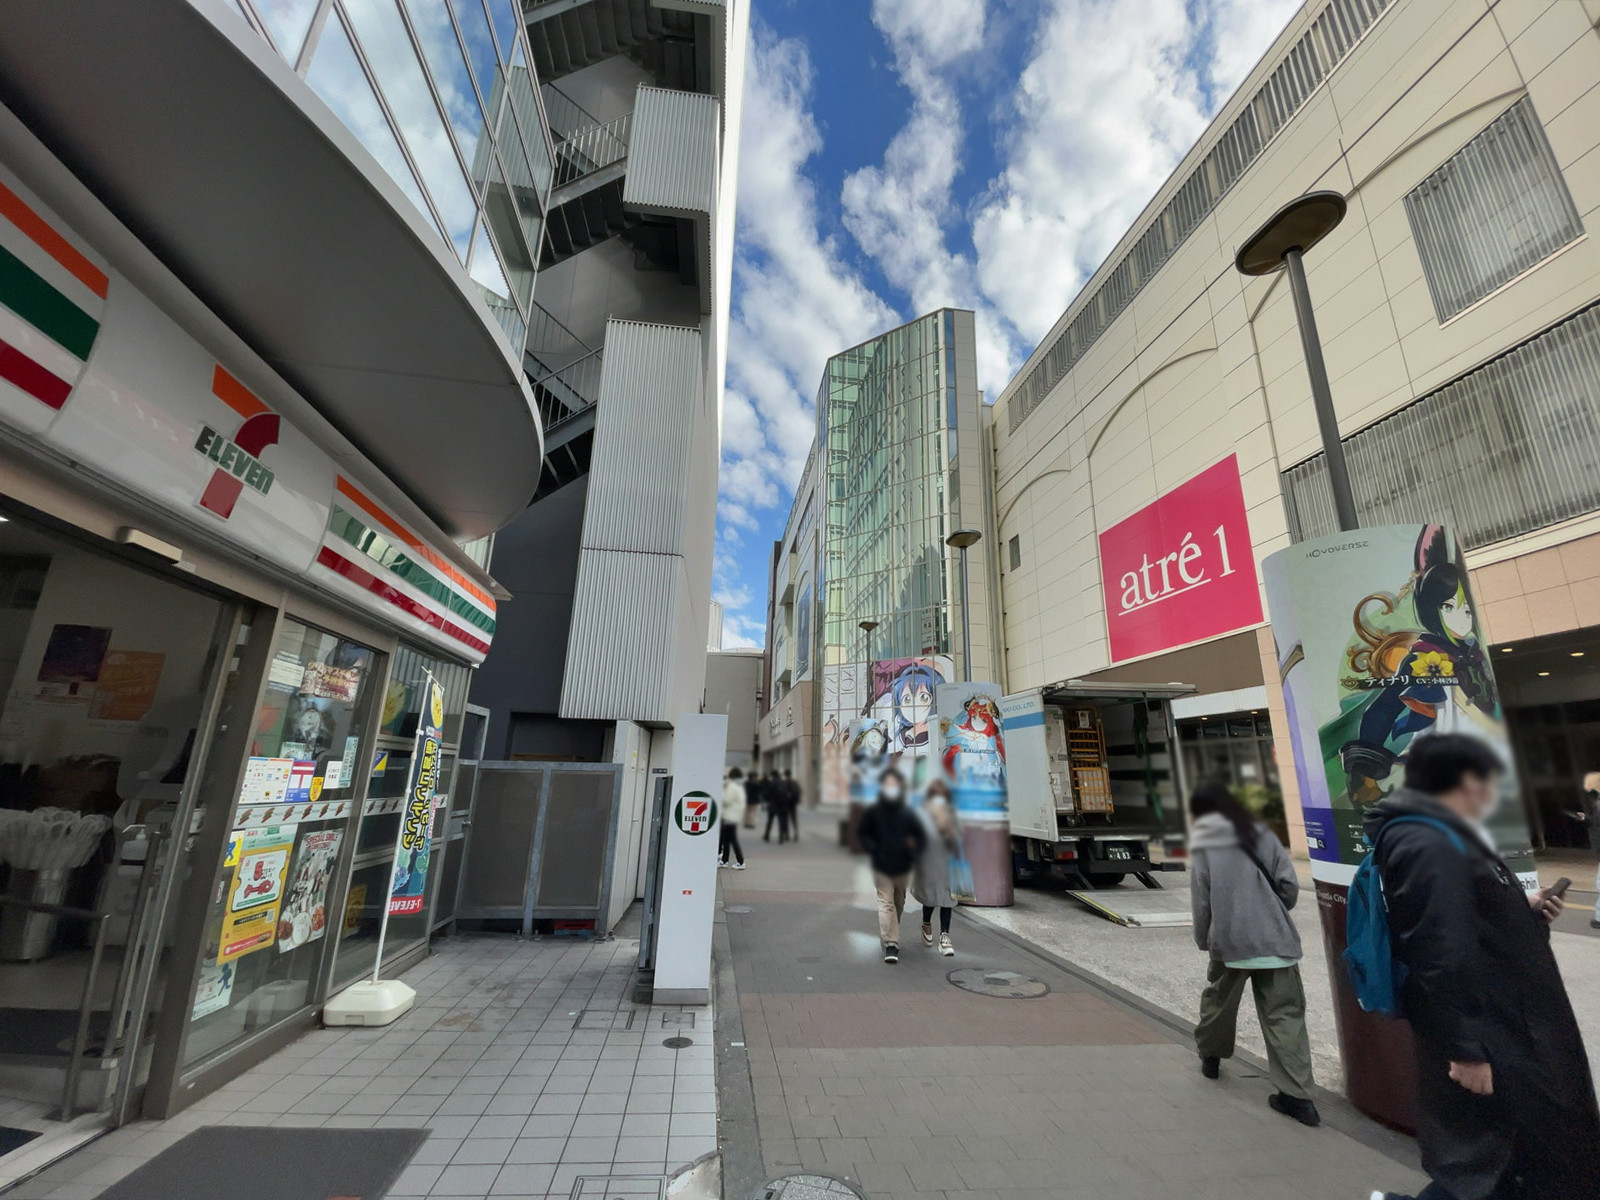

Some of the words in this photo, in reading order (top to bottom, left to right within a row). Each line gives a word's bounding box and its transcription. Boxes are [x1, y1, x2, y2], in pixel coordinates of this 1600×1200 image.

[1120, 531, 1204, 610] atré
[1213, 524, 1236, 577] 1
[1365, 675, 1409, 686] ティナリ
[686, 801, 708, 832] 7
[1520, 877, 1538, 890] shin
